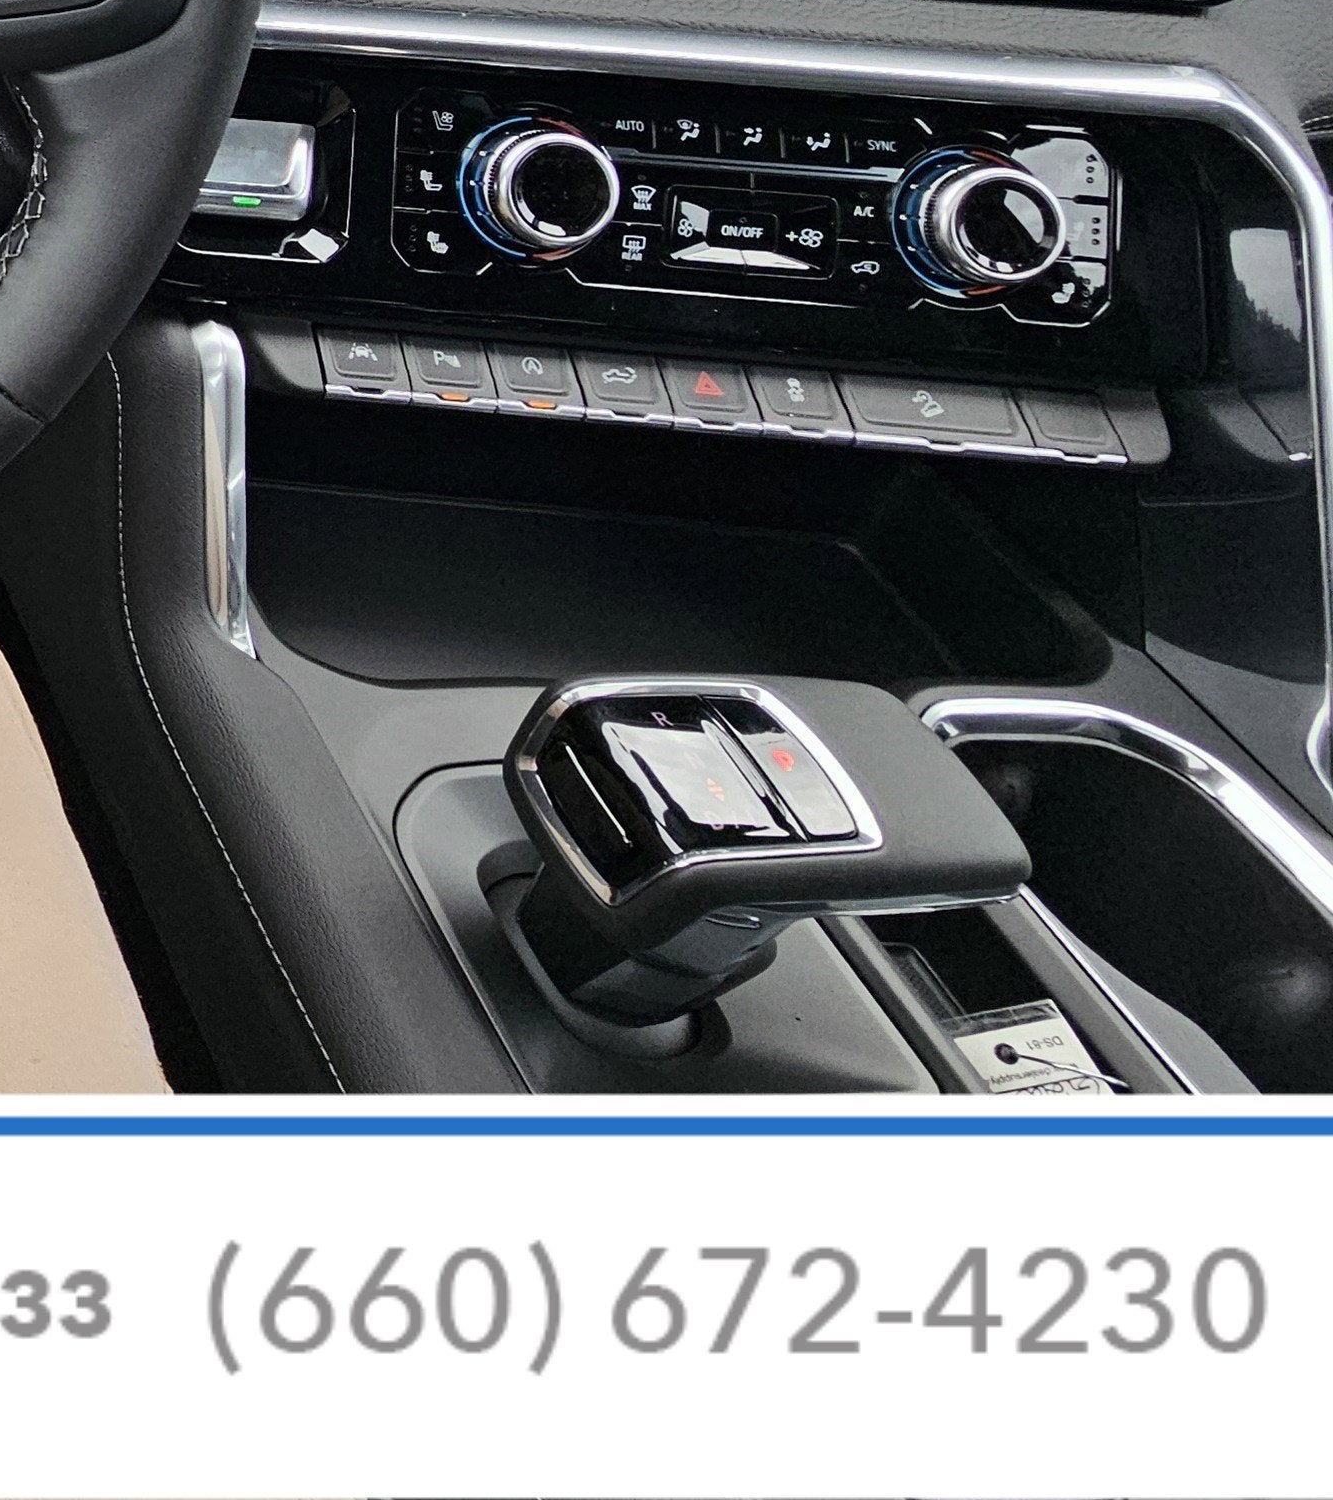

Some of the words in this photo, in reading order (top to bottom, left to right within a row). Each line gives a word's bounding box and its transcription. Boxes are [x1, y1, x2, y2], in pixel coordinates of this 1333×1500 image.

[615, 119, 645, 132] AUTO
[867, 139, 897, 153] SYNC
[633, 201, 652, 212] MAX
[853, 205, 875, 218] A/C
[721, 225, 764, 239] ON/OFF
[651, 711, 674, 728] R
